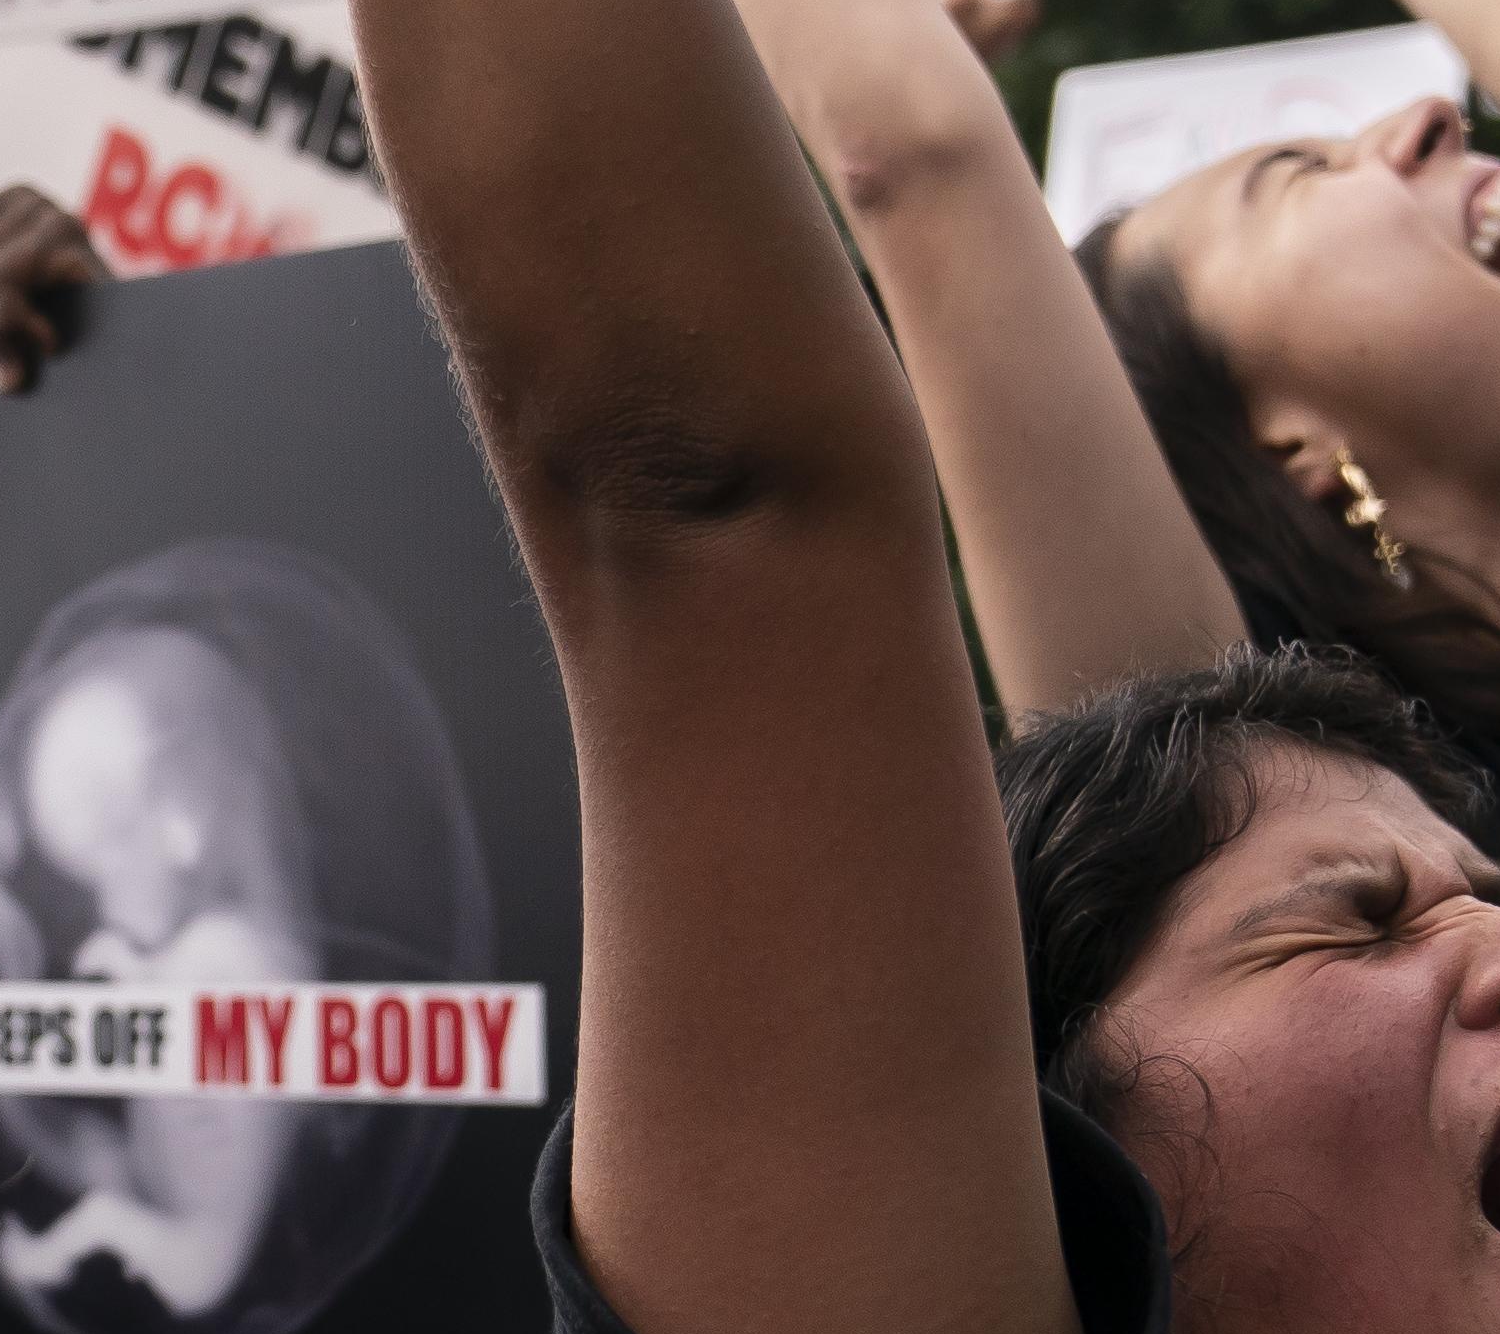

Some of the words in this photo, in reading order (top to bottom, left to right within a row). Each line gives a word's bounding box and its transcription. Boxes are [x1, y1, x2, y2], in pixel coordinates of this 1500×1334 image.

[91, 1007, 171, 1068] OFF
[194, 995, 295, 1087] MY
[316, 995, 516, 1093] BODY
